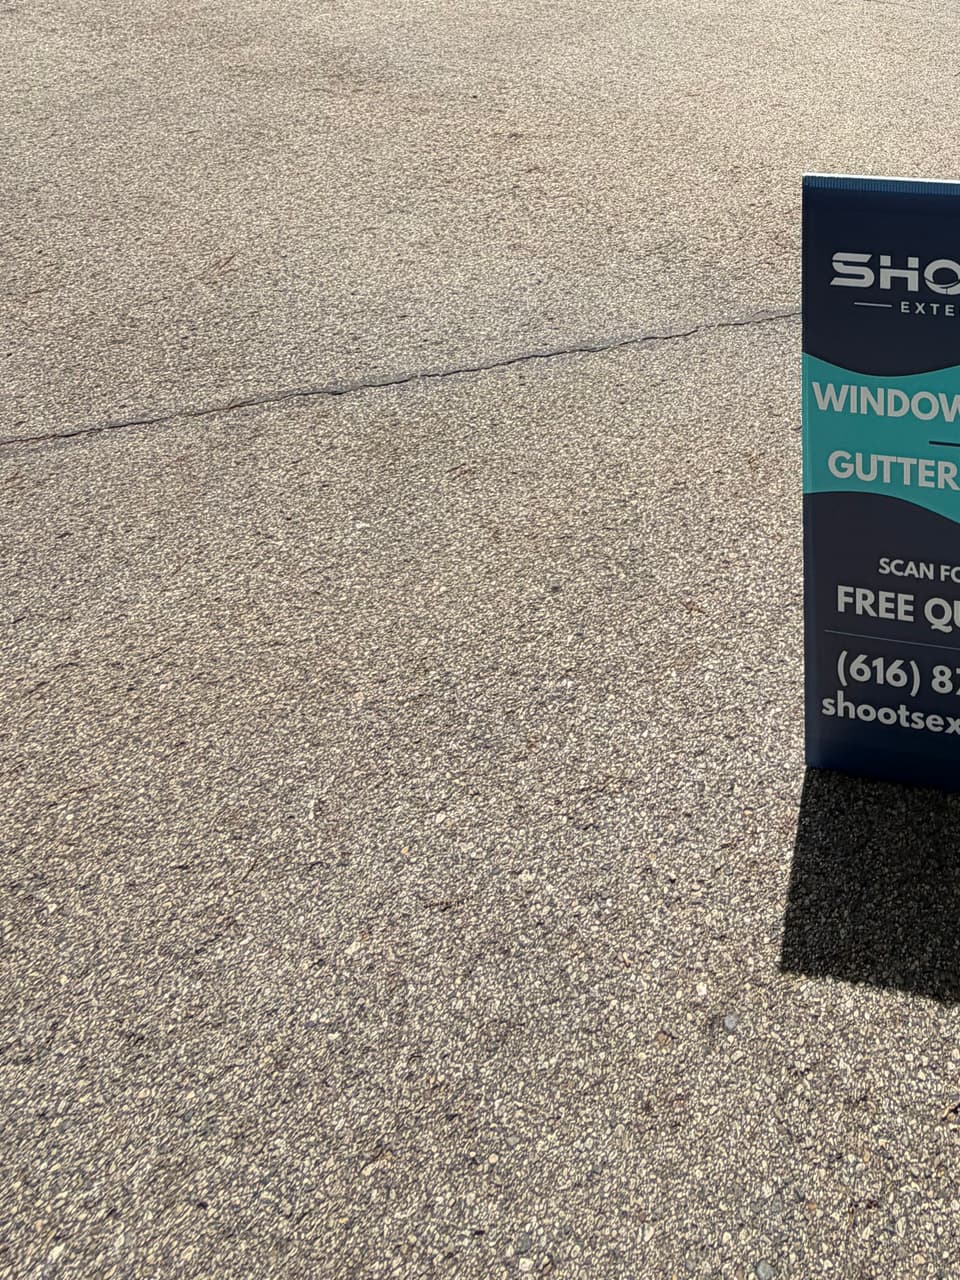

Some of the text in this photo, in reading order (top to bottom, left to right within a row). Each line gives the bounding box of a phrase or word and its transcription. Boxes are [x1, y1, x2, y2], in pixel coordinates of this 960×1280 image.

[828, 450, 960, 490] GUTTER
[878, 557, 934, 580] SCAN
[837, 585, 915, 622] FREE
[837, 650, 921, 697] (616)
